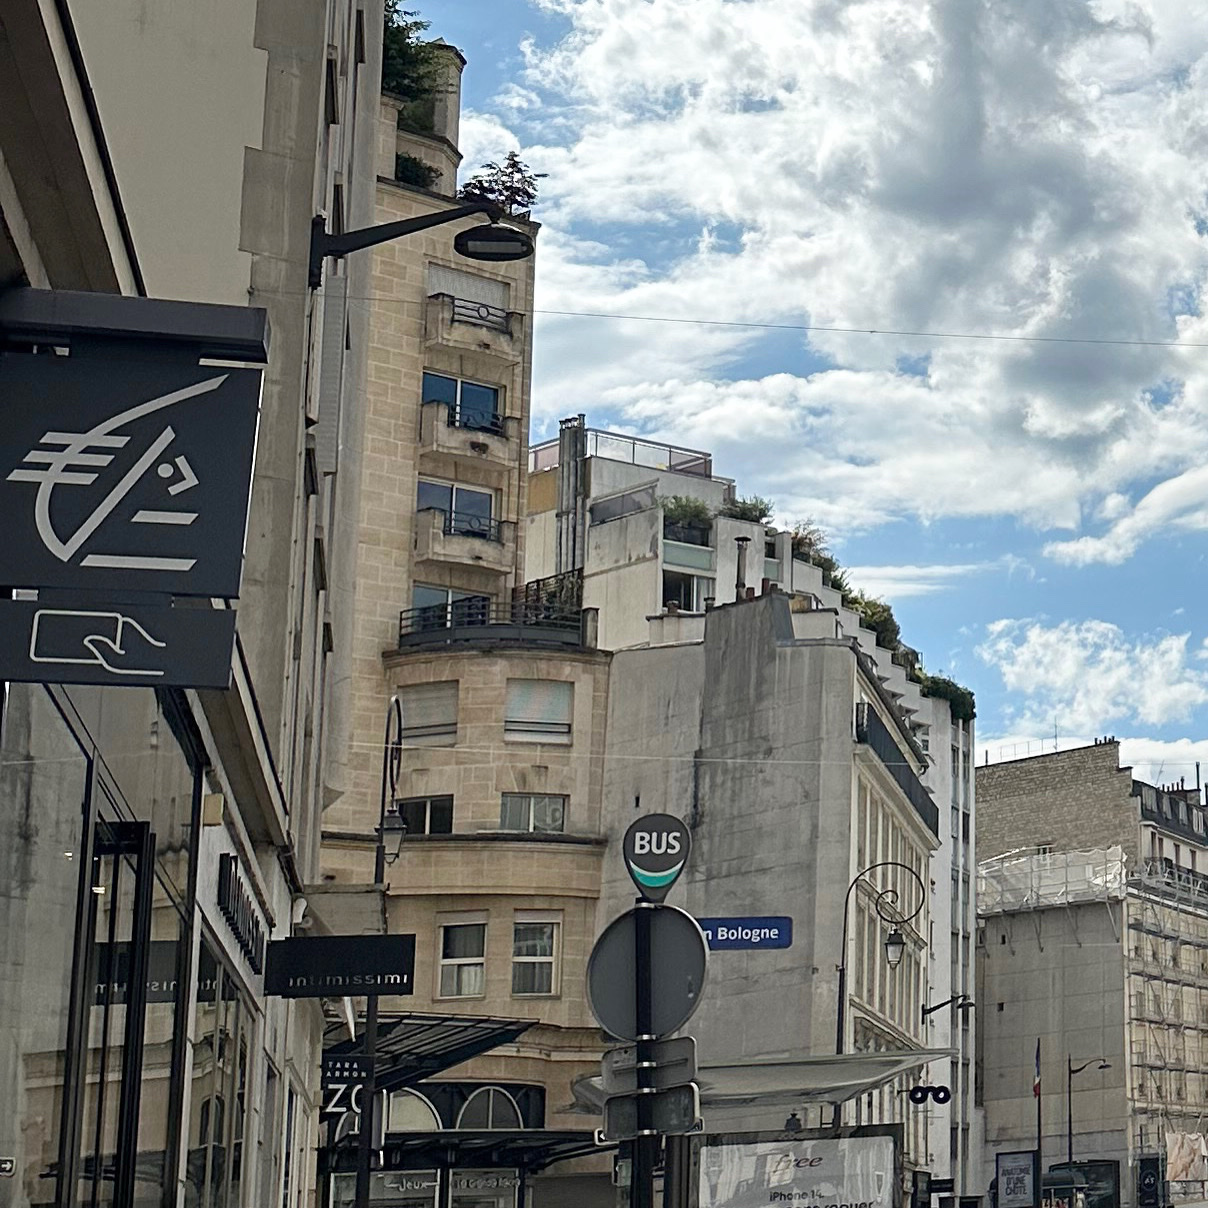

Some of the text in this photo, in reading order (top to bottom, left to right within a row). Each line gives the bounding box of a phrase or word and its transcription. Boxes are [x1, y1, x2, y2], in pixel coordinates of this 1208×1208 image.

[634, 831, 681, 855] BUS
[717, 926, 780, 943] Bologne
[289, 973, 408, 988] intimissimi
[328, 1061, 358, 1069] TARA
[773, 1154, 823, 1173] free
[769, 1192, 808, 1202] iPhone
